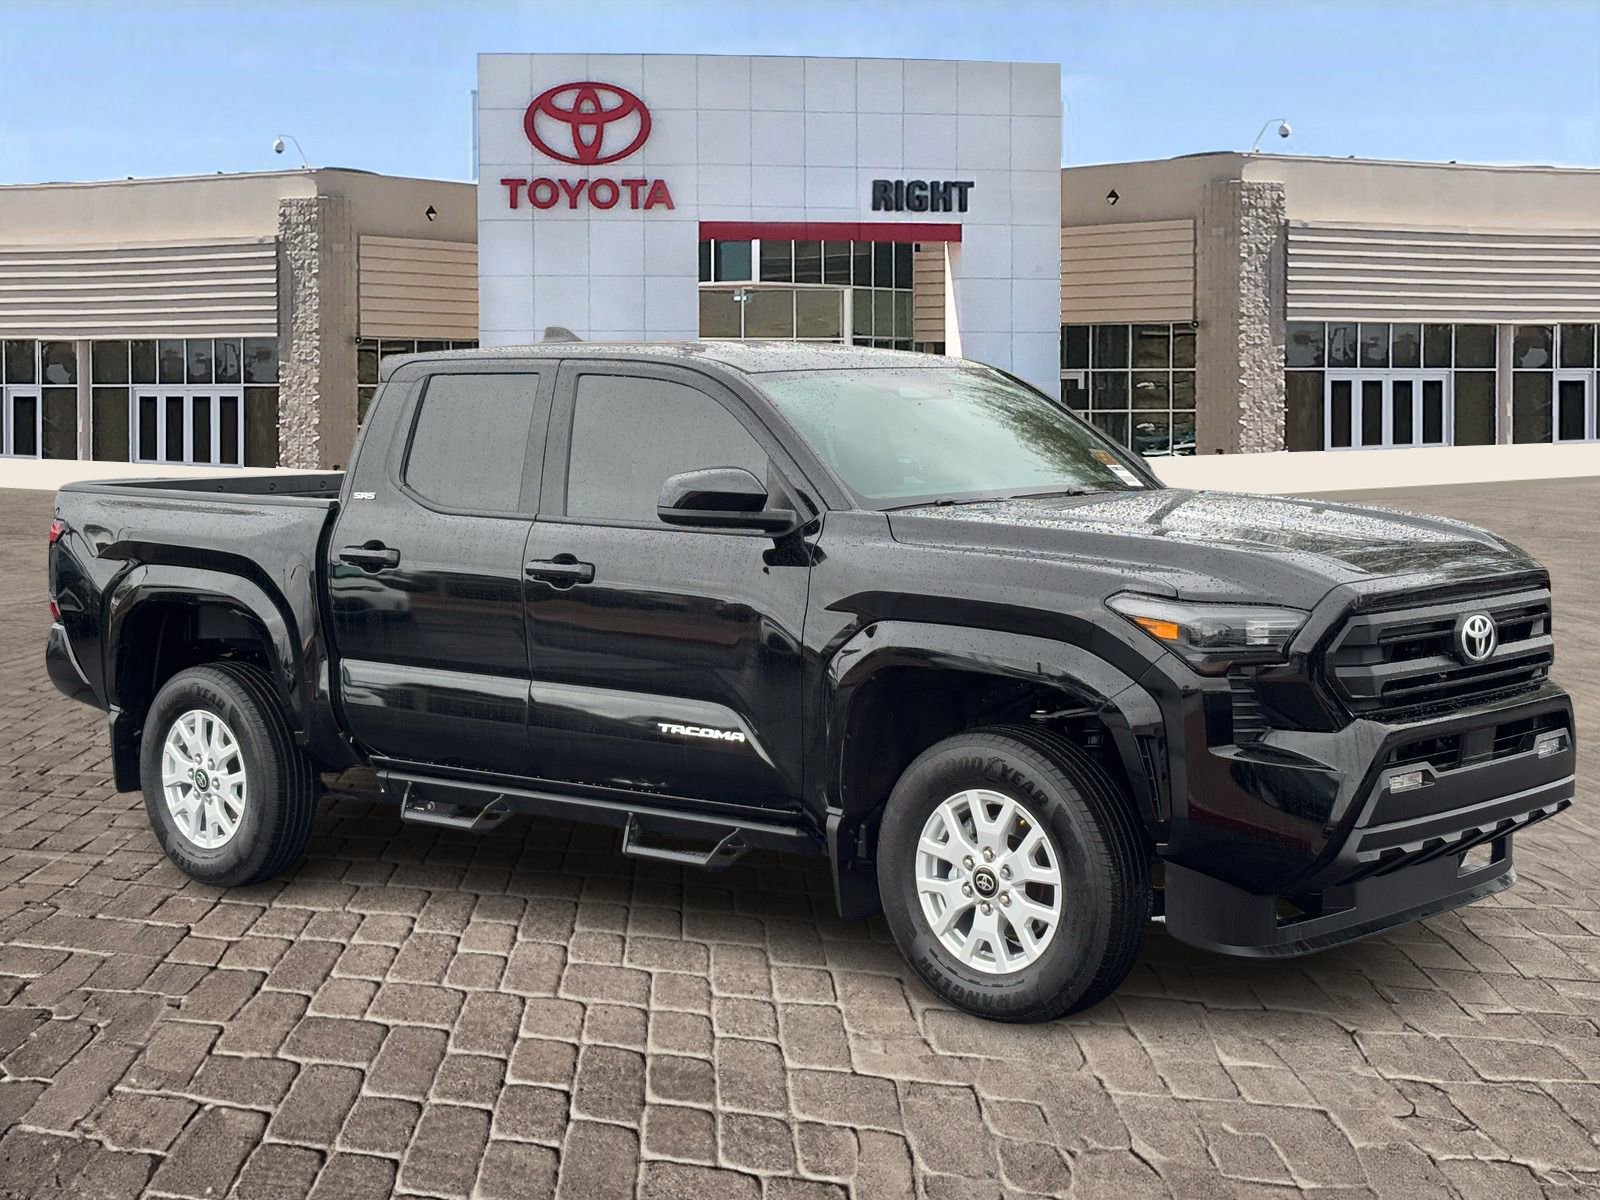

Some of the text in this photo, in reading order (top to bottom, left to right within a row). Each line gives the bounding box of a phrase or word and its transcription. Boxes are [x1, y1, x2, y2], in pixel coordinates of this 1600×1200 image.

[500, 178, 675, 209] TOYOTA
[872, 179, 975, 212] RIGHT
[353, 491, 376, 500] SR5
[657, 722, 746, 743] TACOMA
